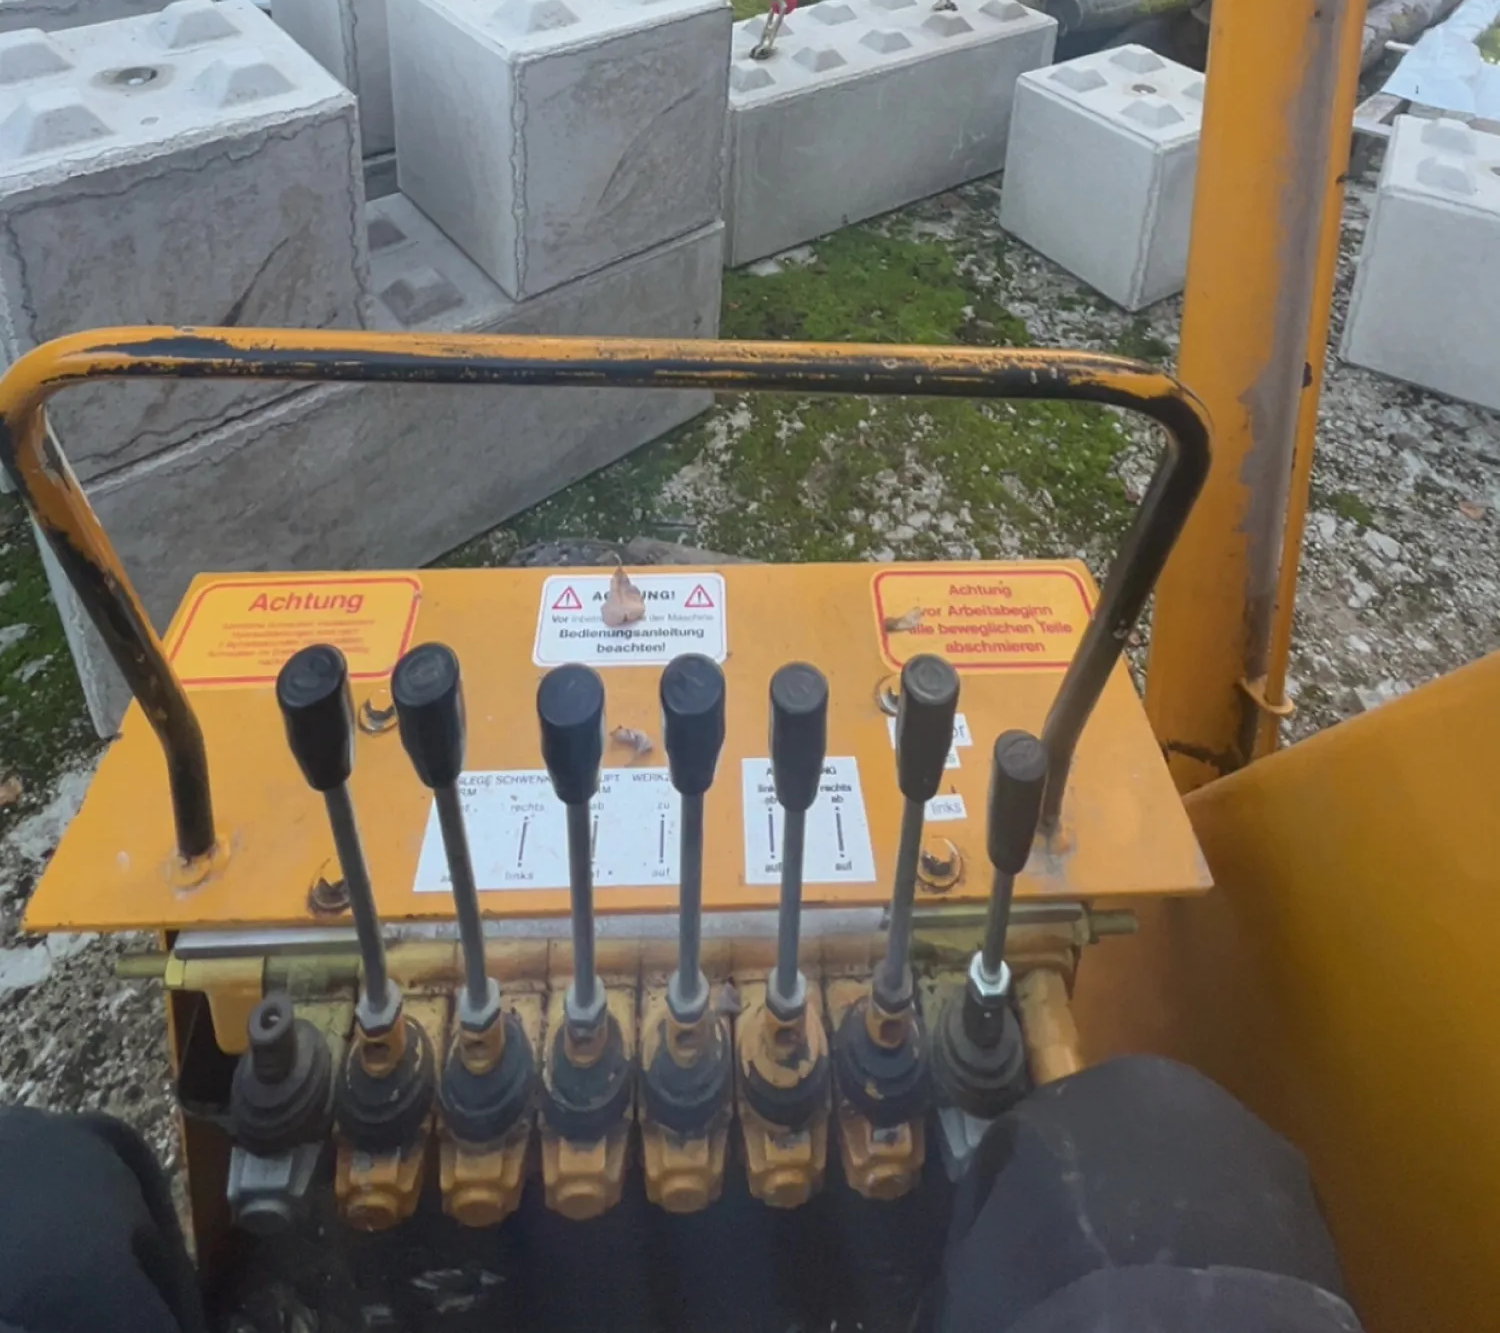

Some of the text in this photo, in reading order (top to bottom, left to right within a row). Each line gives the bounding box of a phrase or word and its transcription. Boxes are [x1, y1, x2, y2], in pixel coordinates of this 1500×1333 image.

[949, 584, 1012, 598] Achtung
[248, 592, 364, 613] Achtung
[948, 604, 1053, 618] Arbeitsbeginn
[551, 615, 568, 623] Vor
[559, 628, 704, 639] Bedienungsanleitung
[938, 621, 1034, 636] beweglichen
[1039, 621, 1073, 634] Teile
[597, 642, 666, 654] beachten!
[945, 639, 1046, 653] abschmieren
[819, 783, 852, 793] rechts
[831, 795, 844, 804] ab
[835, 861, 852, 872] auf
